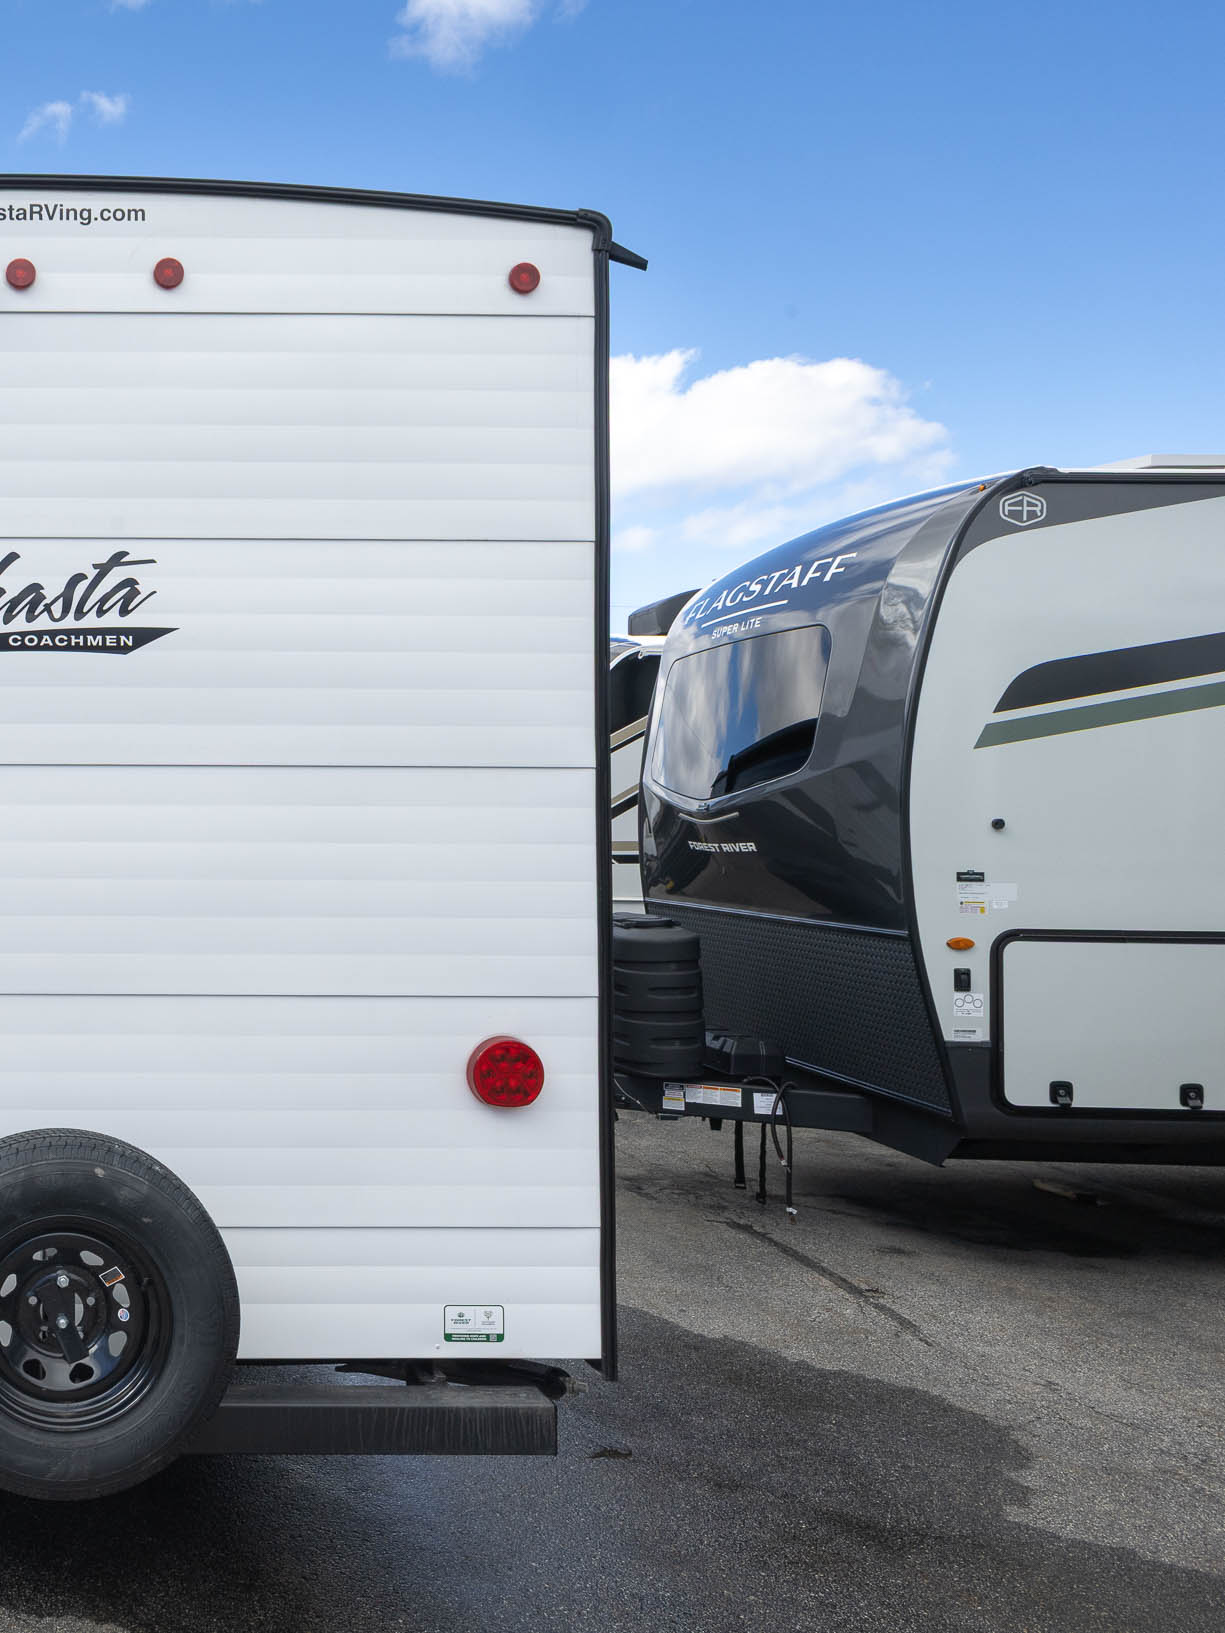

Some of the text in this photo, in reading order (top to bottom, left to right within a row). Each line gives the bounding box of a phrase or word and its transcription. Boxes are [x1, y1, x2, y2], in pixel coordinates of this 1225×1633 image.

[685, 552, 858, 624] FLAGSTAFF
[712, 616, 762, 640] SUPER LITE
[8, 634, 134, 648] COACHMEN
[688, 841, 757, 852] FOREST RIVER
